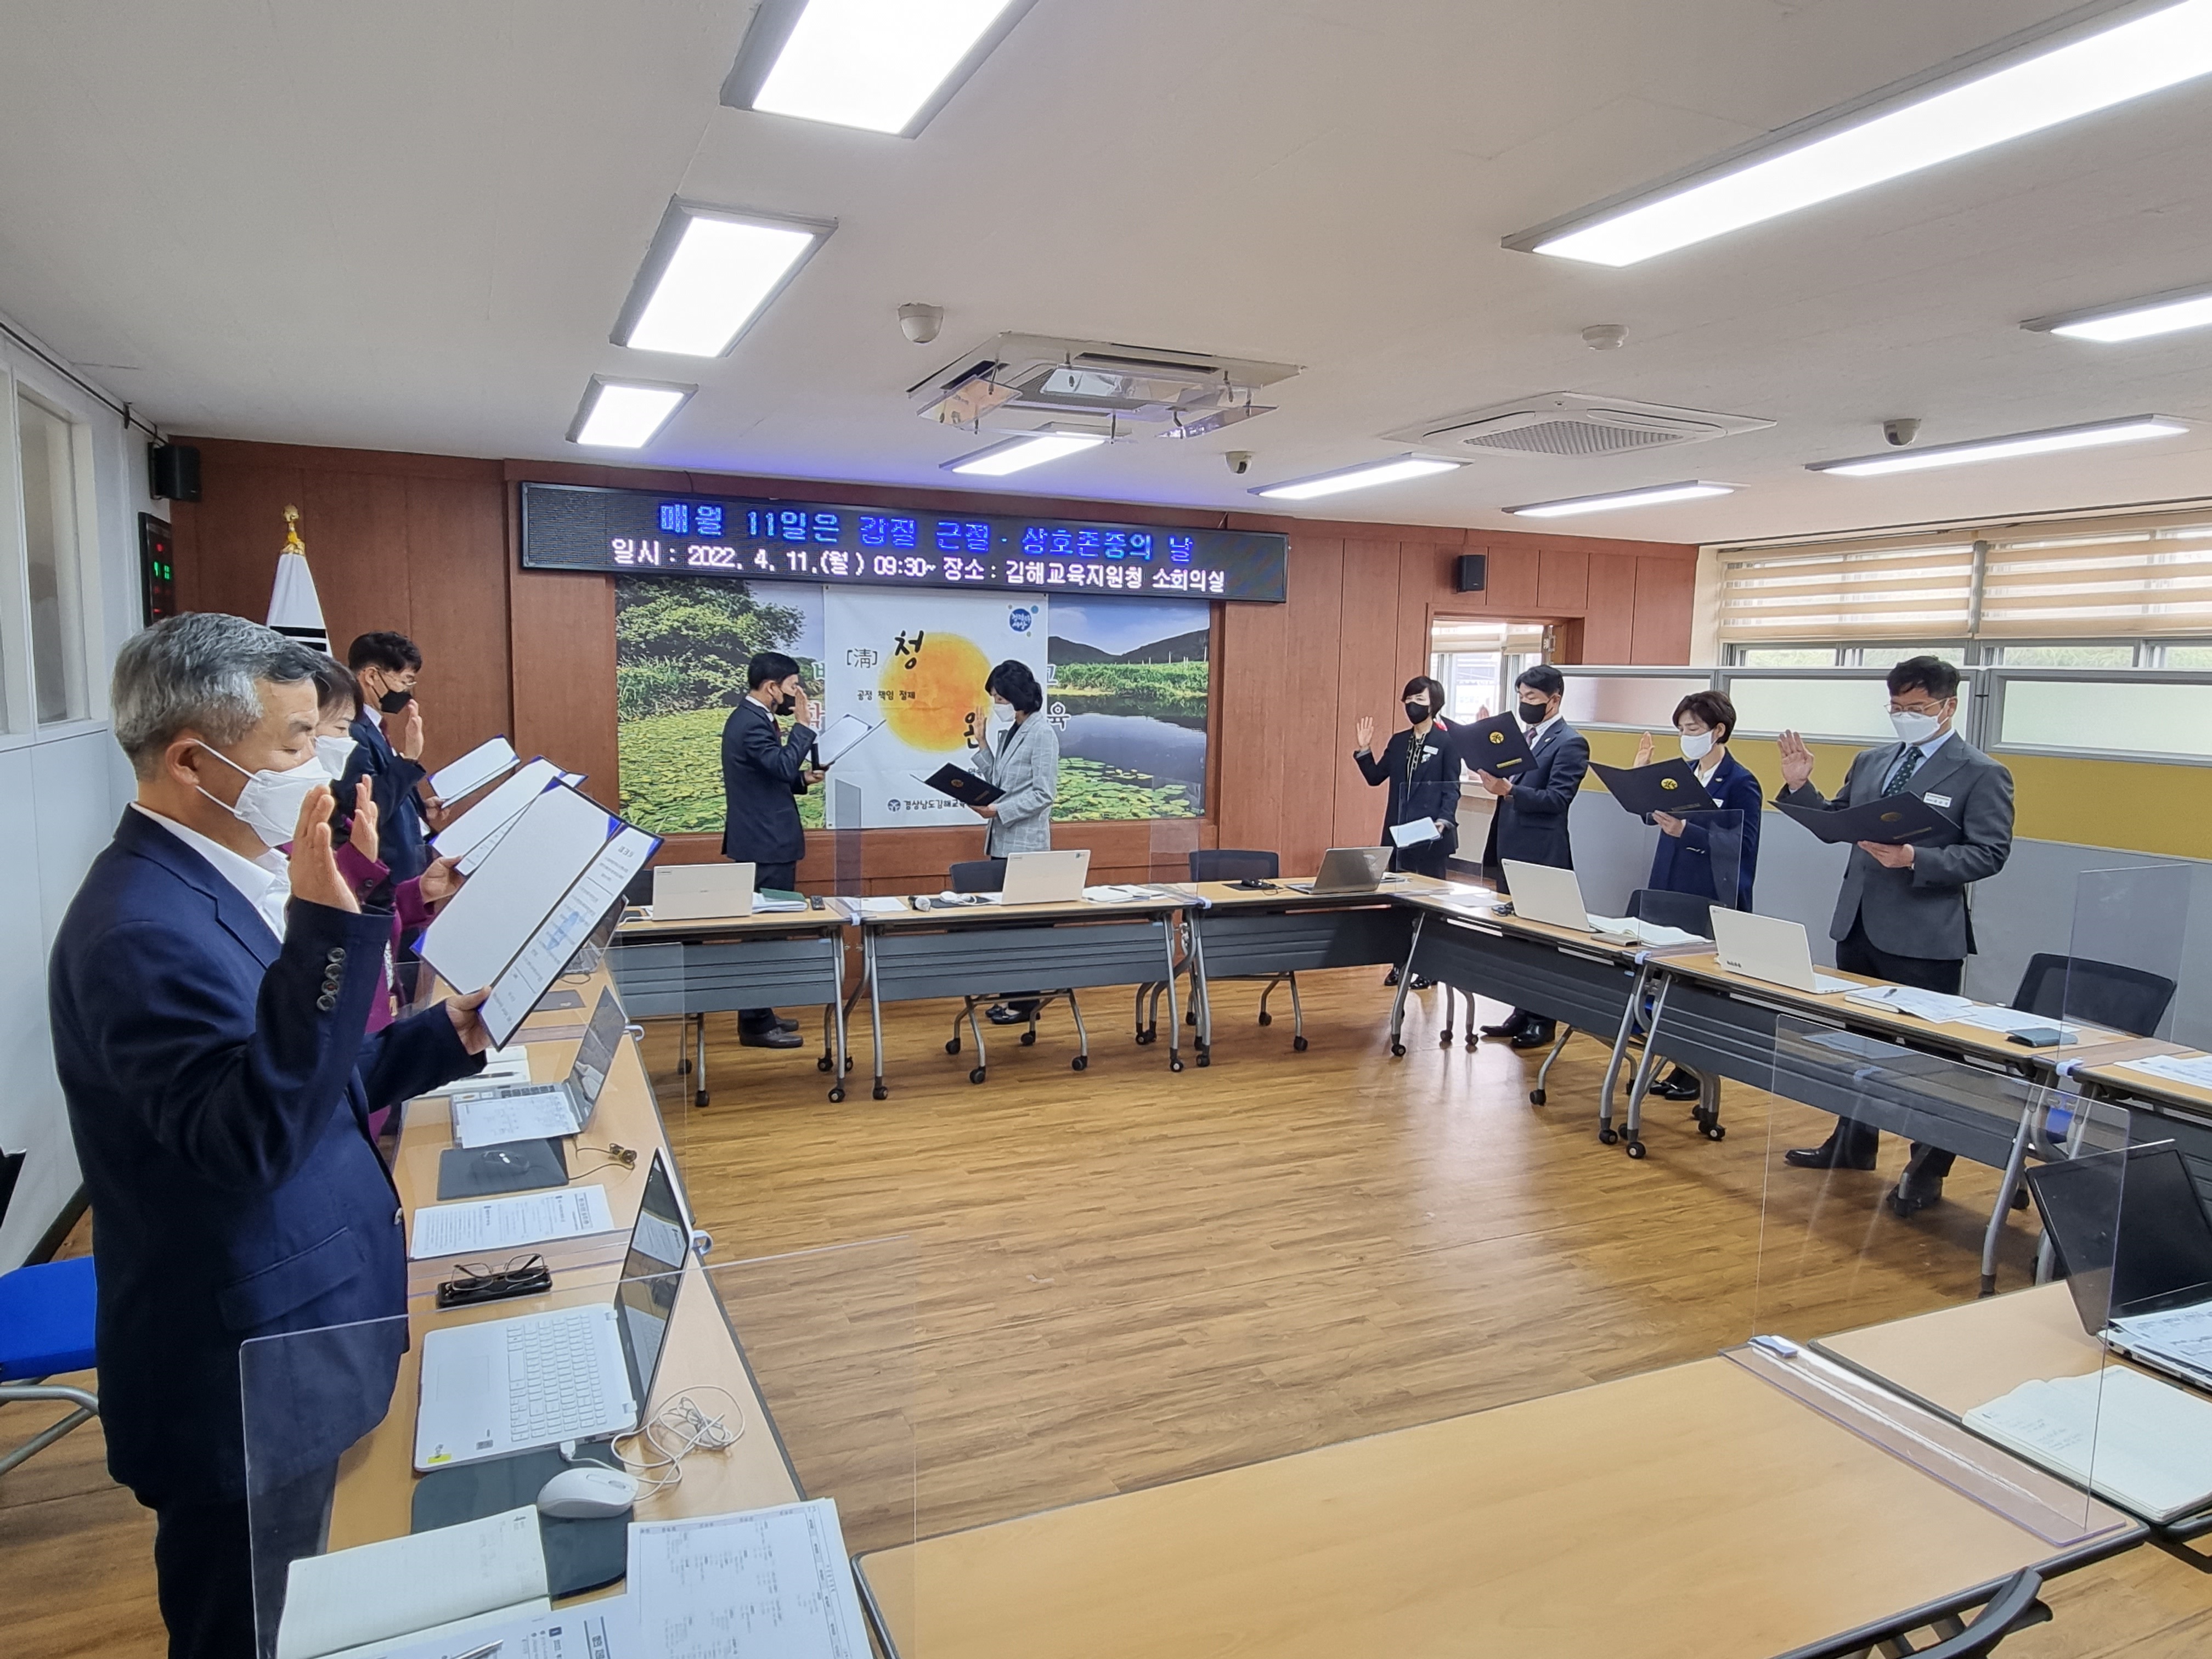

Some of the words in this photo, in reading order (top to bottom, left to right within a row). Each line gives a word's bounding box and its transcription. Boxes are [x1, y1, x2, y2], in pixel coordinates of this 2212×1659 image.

[660, 504, 722, 537] 매월
[748, 511, 839, 543] 11일은
[860, 516, 915, 546] 갑질
[936, 522, 989, 551] 근절
[1022, 527, 1151, 561] 상호존중의
[1169, 537, 1193, 562] 날
[611, 538, 659, 566] 일시
[687, 544, 743, 571] 2022.
[754, 548, 775, 572] 4.
[943, 556, 985, 581] 장소
[1006, 560, 1143, 589] 김해교육지원청
[1152, 567, 1225, 594] 소회의실
[894, 630, 924, 669] 청
[857, 690, 873, 701] 공정
[878, 690, 894, 701] 책임
[899, 690, 916, 701] 절제
